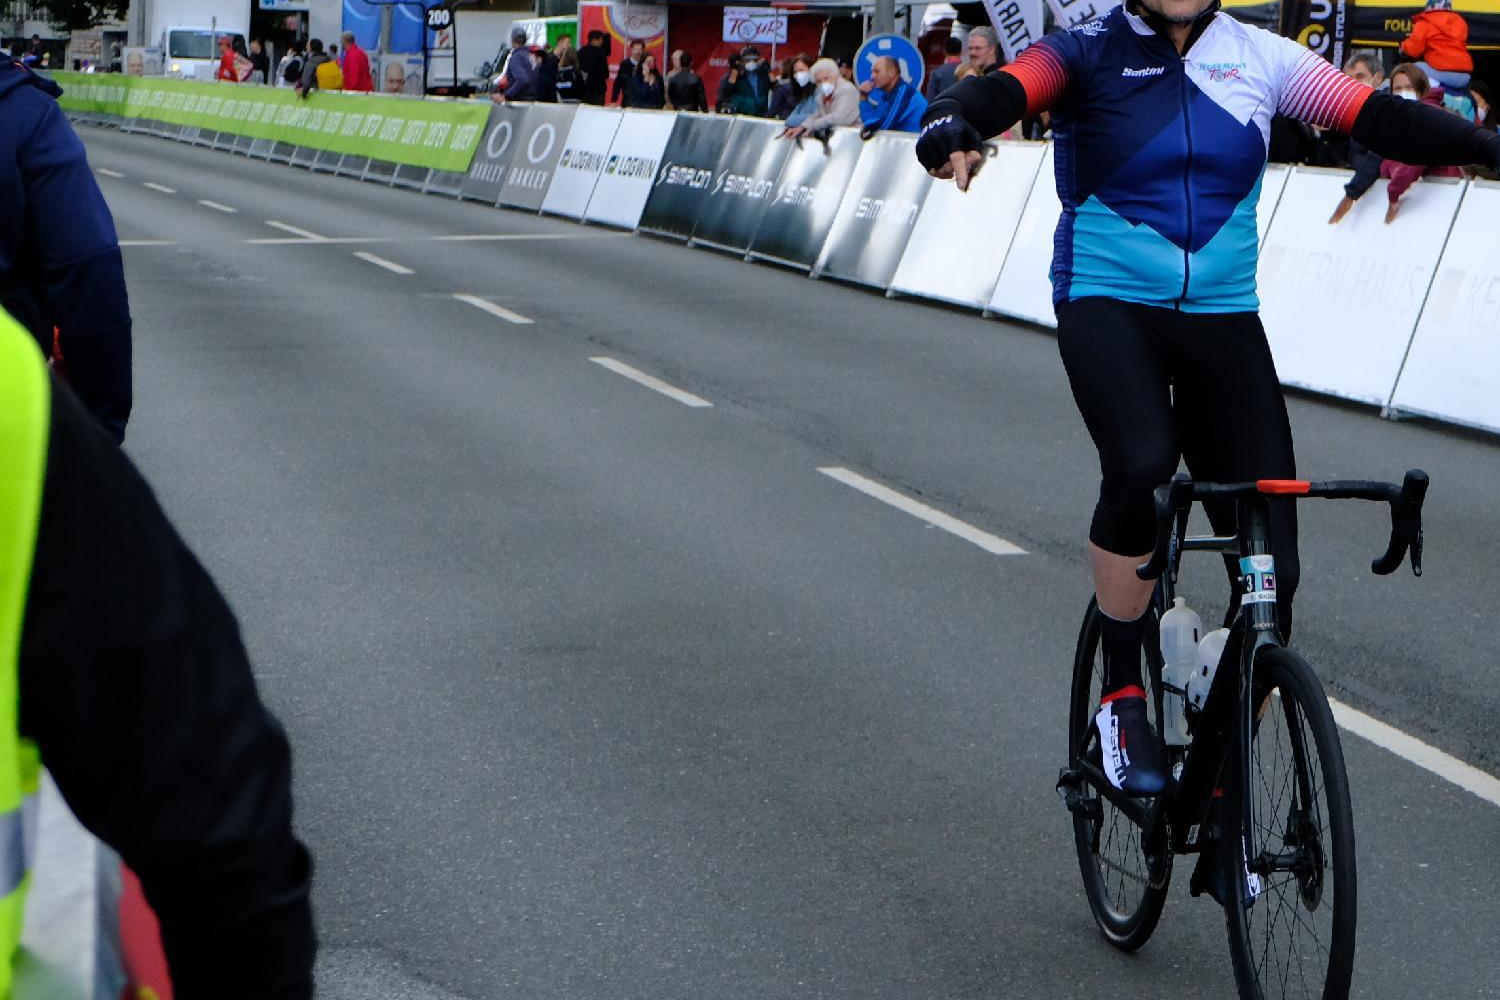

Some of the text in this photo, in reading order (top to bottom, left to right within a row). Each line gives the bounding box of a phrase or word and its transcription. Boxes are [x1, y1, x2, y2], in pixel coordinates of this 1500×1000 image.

[428, 9, 450, 26] 200
[1384, 17, 1413, 32] rou
[470, 162, 505, 182] OAKLEY
[570, 151, 603, 171] LOGWIN
[618, 154, 657, 179] LOGWIN
[509, 167, 549, 189] OAKLEY
[667, 165, 712, 190] SIMPLON
[723, 174, 773, 199] SIMPLON
[1284, 249, 1426, 315] KERN-HAUS
